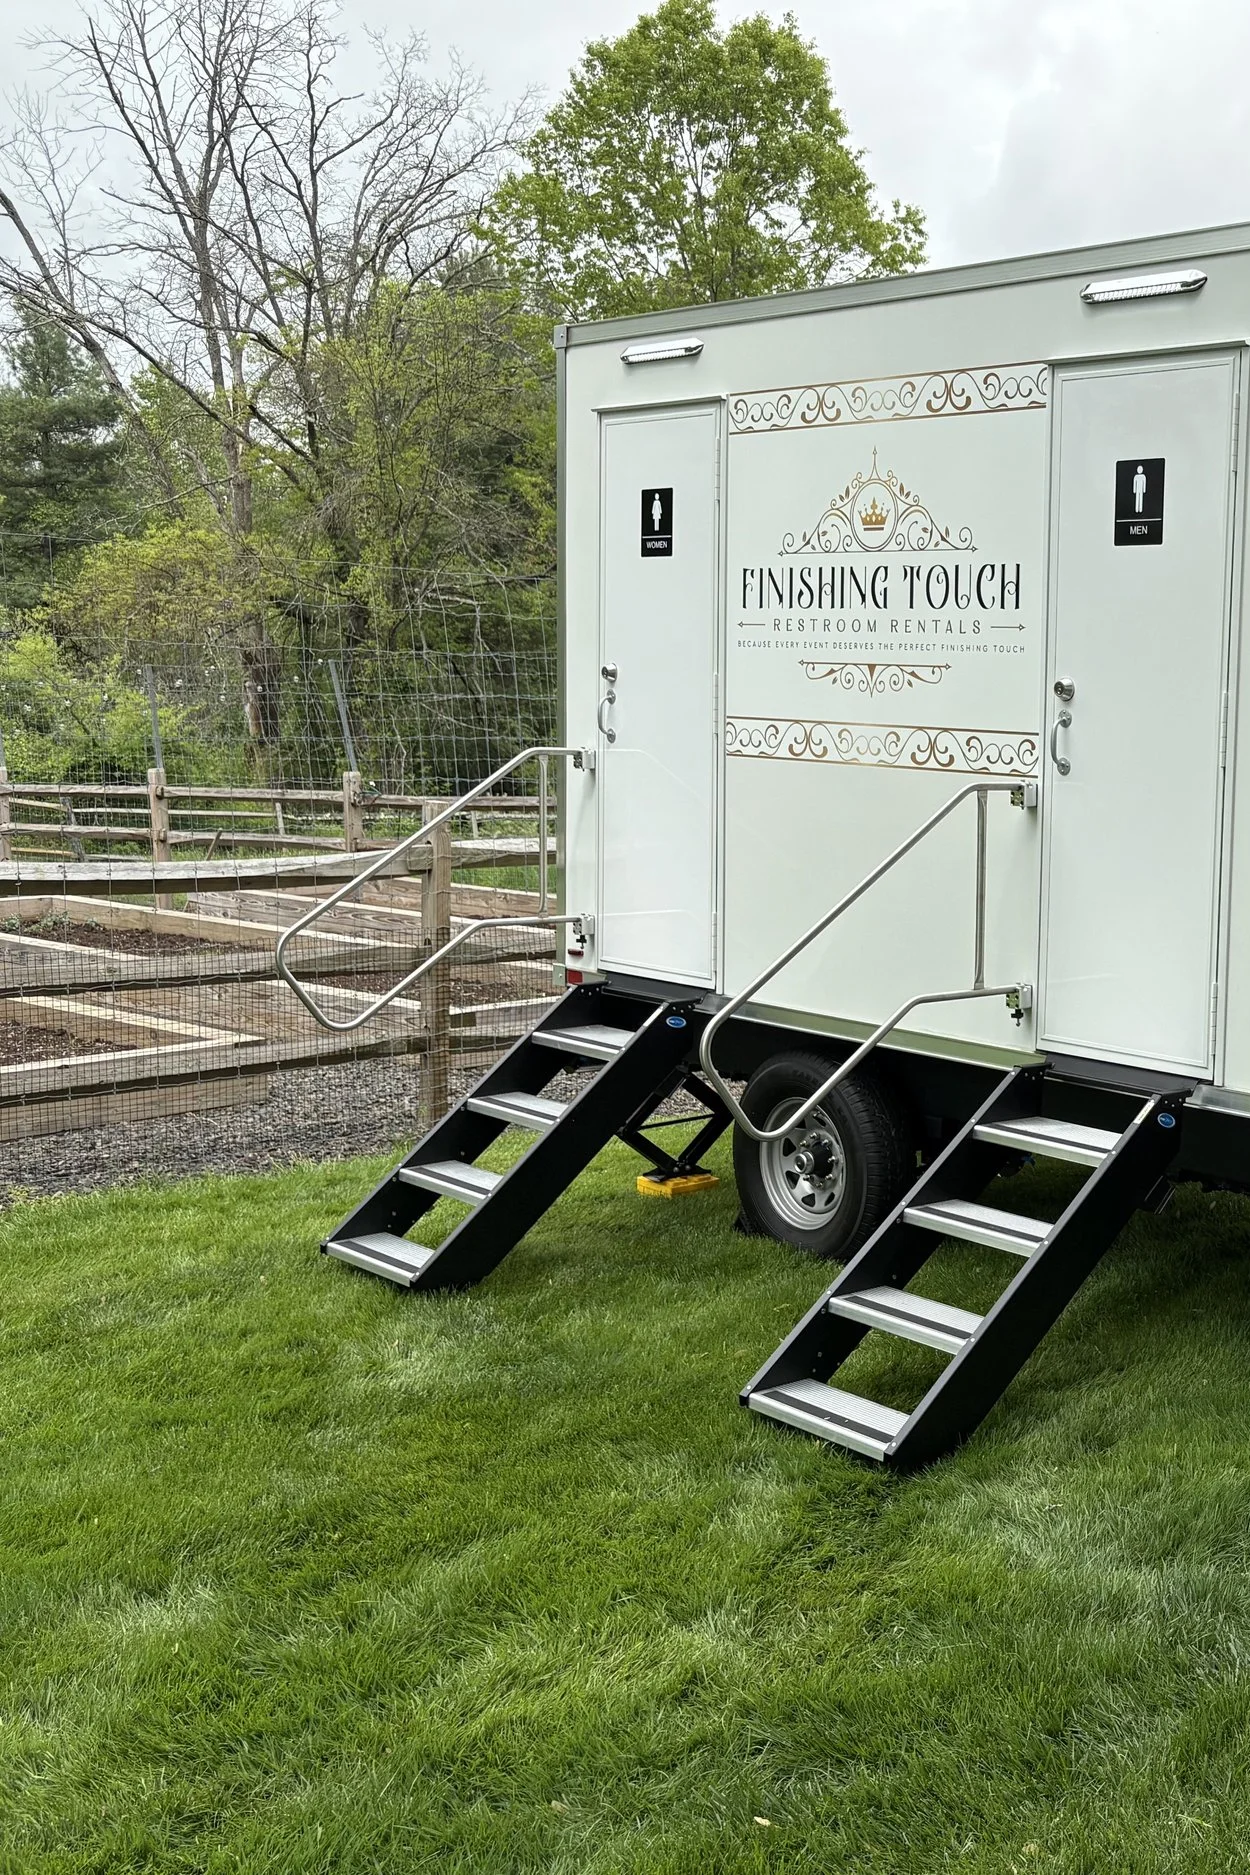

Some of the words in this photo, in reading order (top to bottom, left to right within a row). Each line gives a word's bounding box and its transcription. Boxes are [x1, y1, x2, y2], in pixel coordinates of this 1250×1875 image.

[1129, 525, 1148, 534] MEN
[646, 540, 667, 548] WOMEN
[742, 565, 889, 609] FINISHING
[902, 563, 1021, 609] TOUCH
[773, 618, 877, 632] RESTROOM
[890, 619, 981, 634] RENTALS
[737, 640, 771, 648] BECAUSE
[775, 641, 799, 649] EVERY
[803, 641, 829, 649] EVENT
[833, 641, 874, 650] DESERVES
[879, 642, 894, 650] THE
[898, 643, 936, 651] PERFECT
[941, 643, 988, 652] FINISHING
[993, 644, 1025, 653] TOUCH
